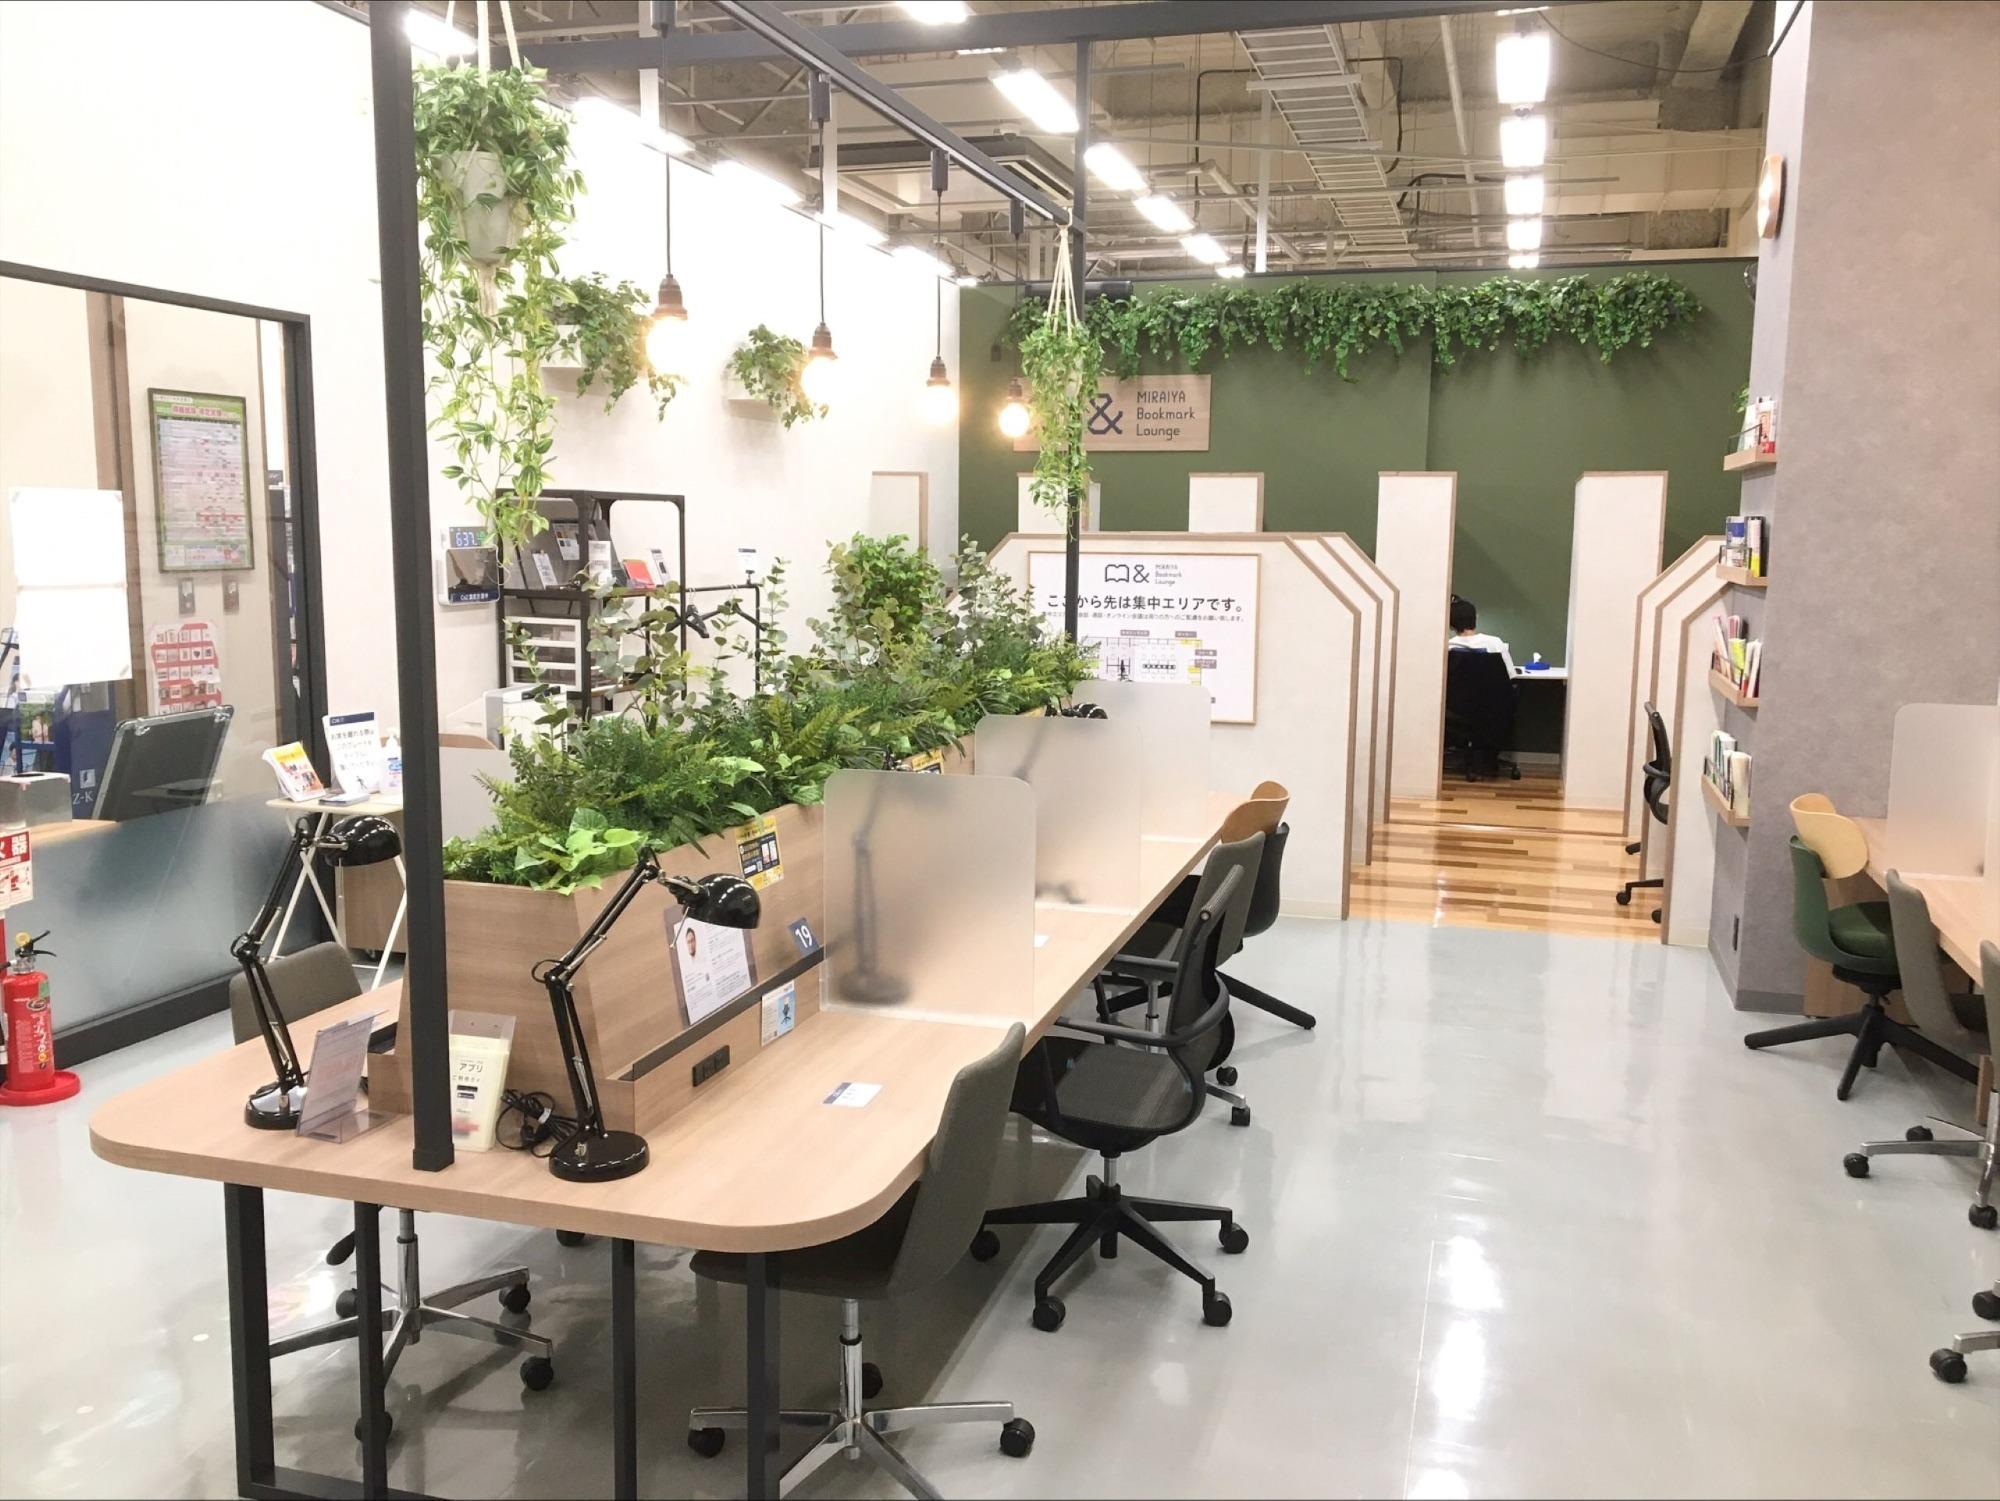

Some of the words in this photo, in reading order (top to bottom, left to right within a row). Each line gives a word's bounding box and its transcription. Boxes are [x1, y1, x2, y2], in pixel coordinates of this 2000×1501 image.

[1137, 390, 1186, 403] MIRAIYA
[1137, 407, 1196, 420] Bookmark
[1136, 424, 1181, 441] Lounge
[1155, 570, 1182, 578] Bookmark
[1155, 578, 1176, 588] Lounge
[795, 924, 813, 949] 19
